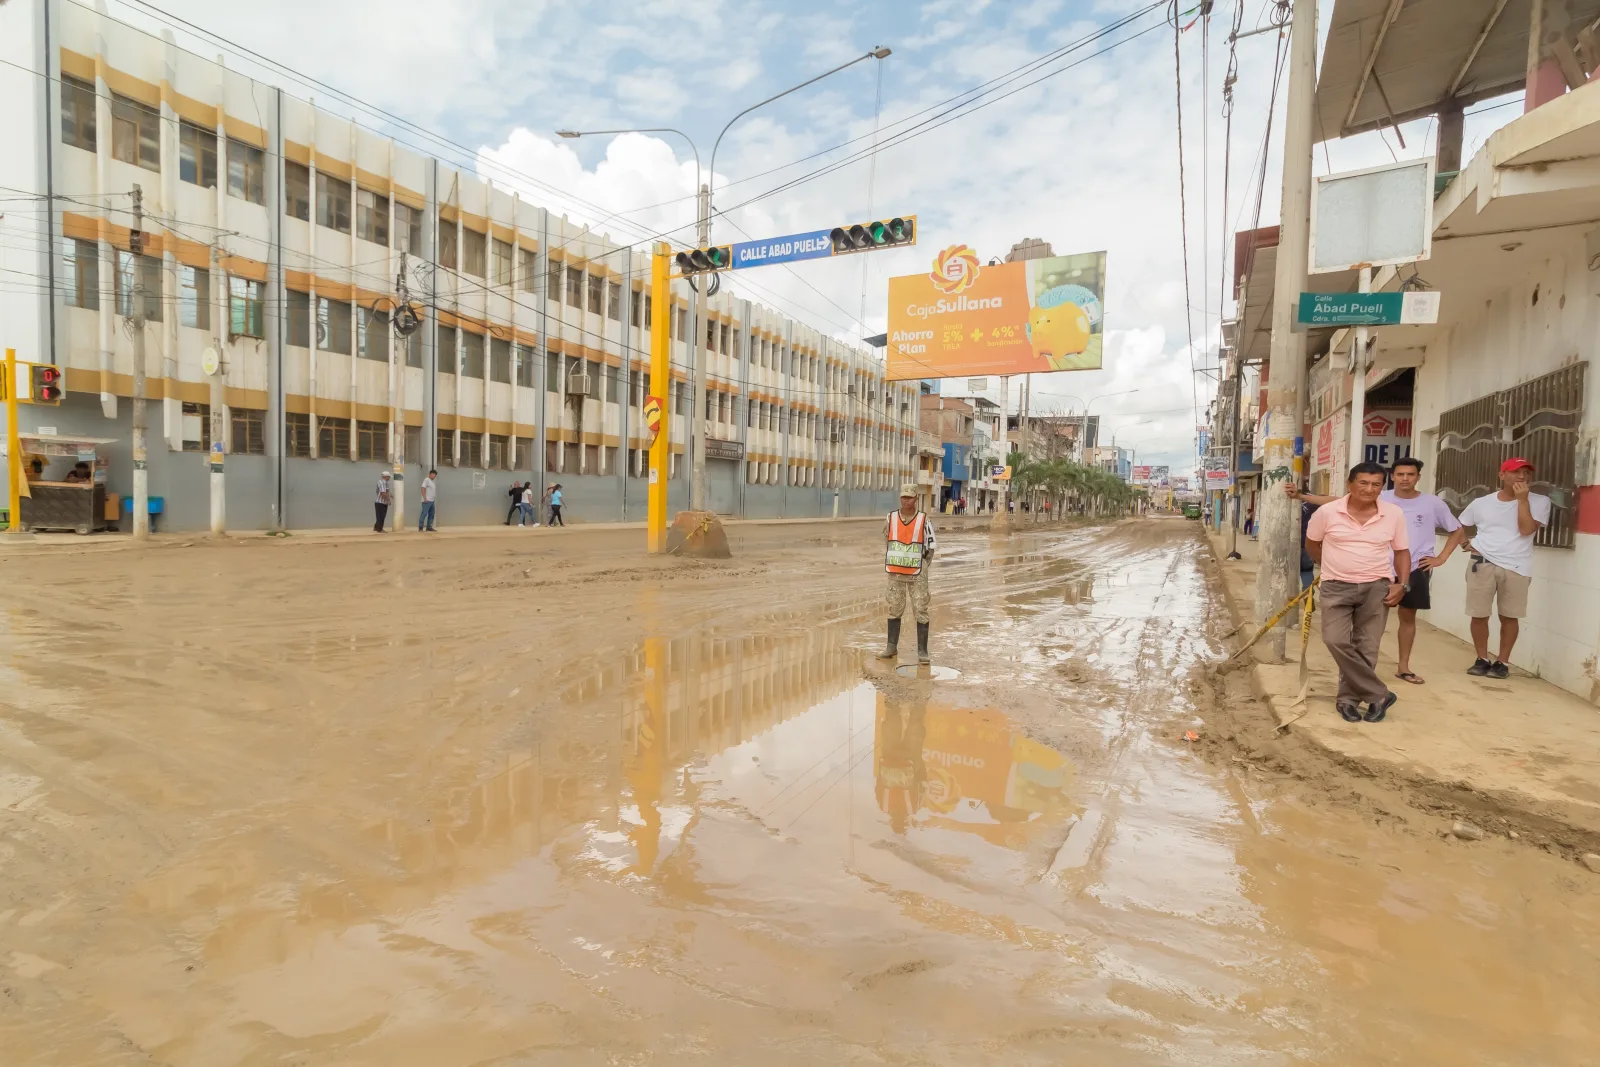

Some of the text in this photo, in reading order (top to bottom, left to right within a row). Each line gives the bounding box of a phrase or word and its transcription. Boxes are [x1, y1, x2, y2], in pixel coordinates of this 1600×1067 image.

[740, 238, 822, 262] CALLE ABAD PUELL
[906, 295, 1003, 320] CajaSullana
[1313, 303, 1383, 313] Abad Puell
[891, 330, 934, 342] Ahorro
[898, 343, 926, 354] Plan
[1365, 444, 1389, 464] DE
